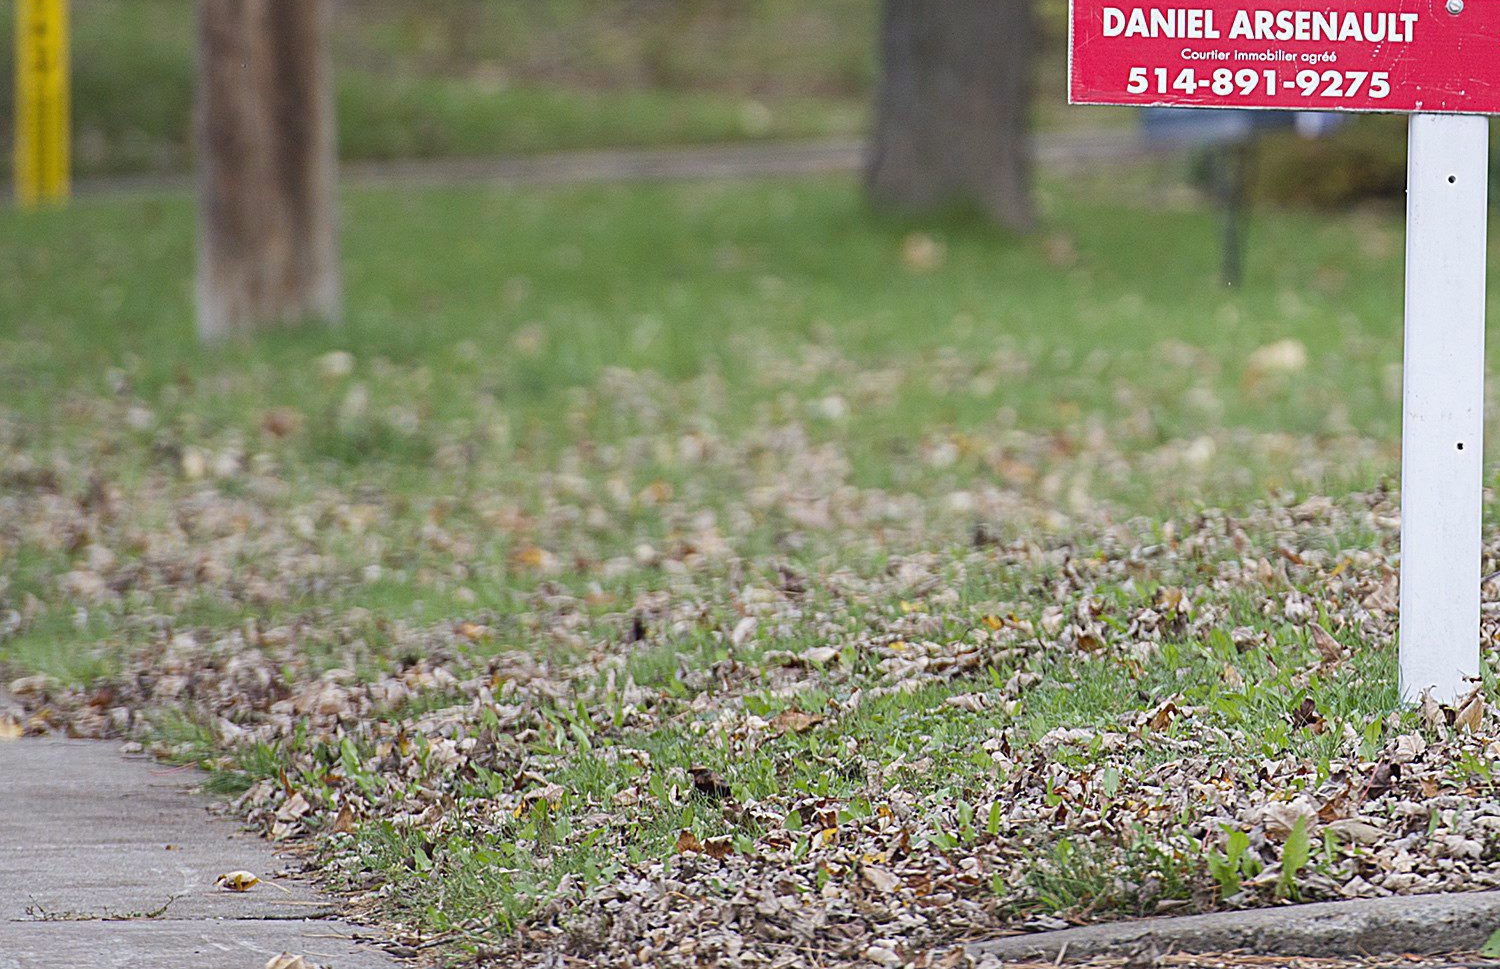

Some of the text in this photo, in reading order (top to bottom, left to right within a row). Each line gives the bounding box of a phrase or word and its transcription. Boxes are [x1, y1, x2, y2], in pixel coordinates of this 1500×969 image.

[1102, 7, 1418, 43] DANIEL ARSENAULT
[1180, 48, 1337, 65] Courtier immobilier agréé
[1126, 68, 1391, 99] 514-891-9275
